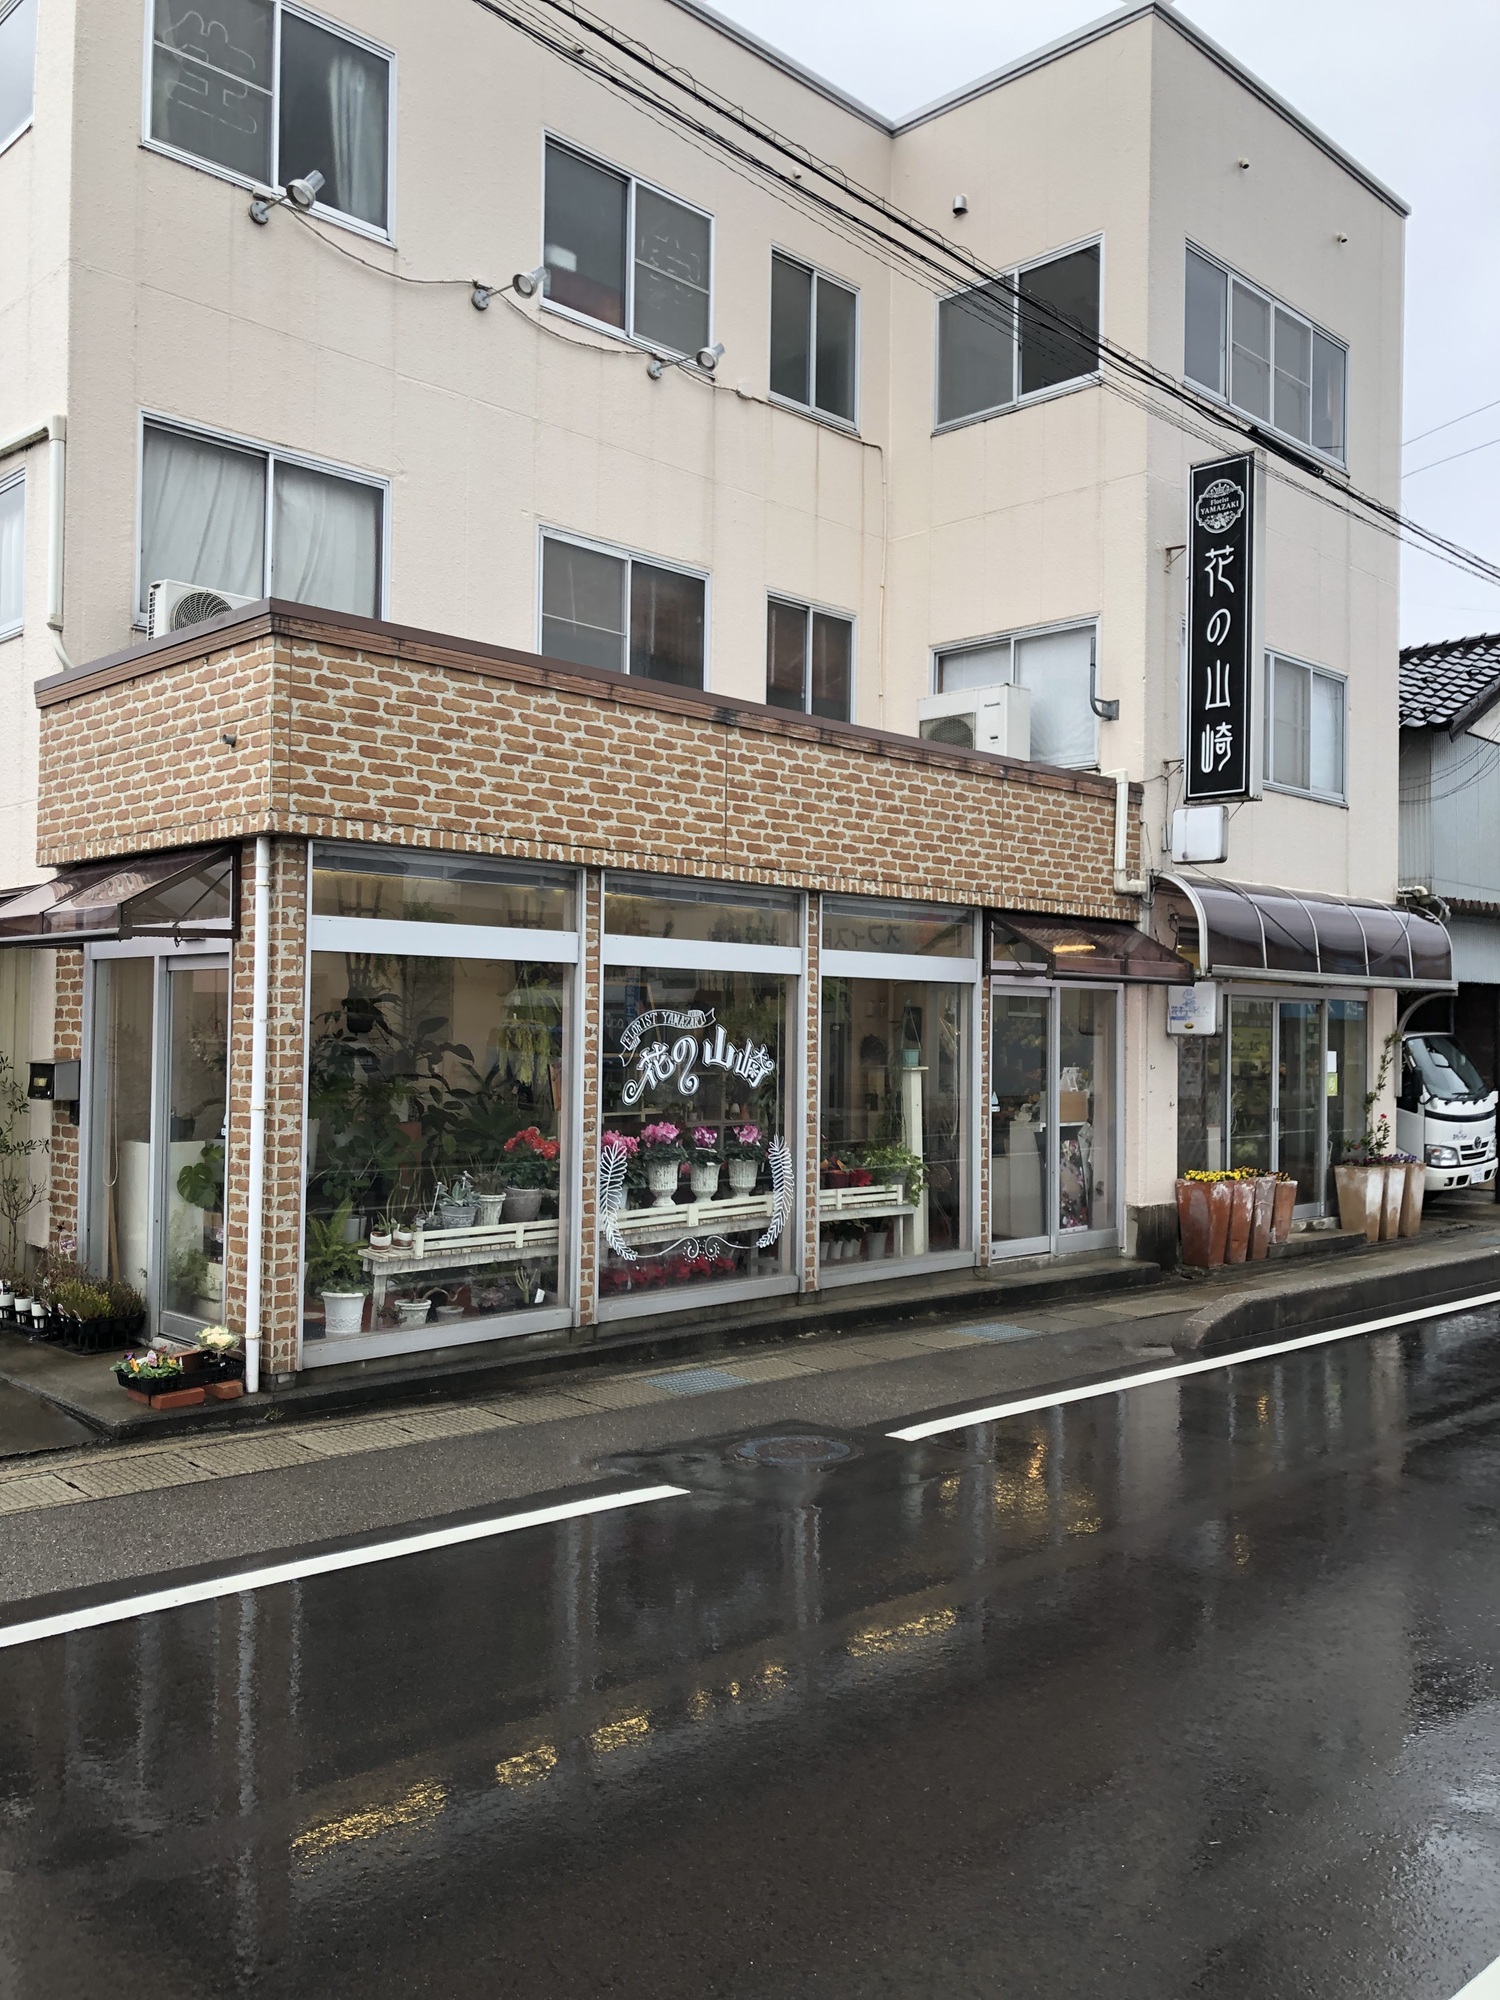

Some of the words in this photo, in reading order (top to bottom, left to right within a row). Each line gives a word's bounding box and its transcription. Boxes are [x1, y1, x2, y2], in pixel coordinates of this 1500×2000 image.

[1200, 500, 1239, 515] YAMAZAKI
[1210, 497, 1229, 506] Florist
[1202, 544, 1235, 774] 花の山崎
[623, 1012, 658, 1044] FLORIST
[661, 1012, 706, 1027] YAMAZAKI
[622, 1024, 775, 1105] 花の山崎
